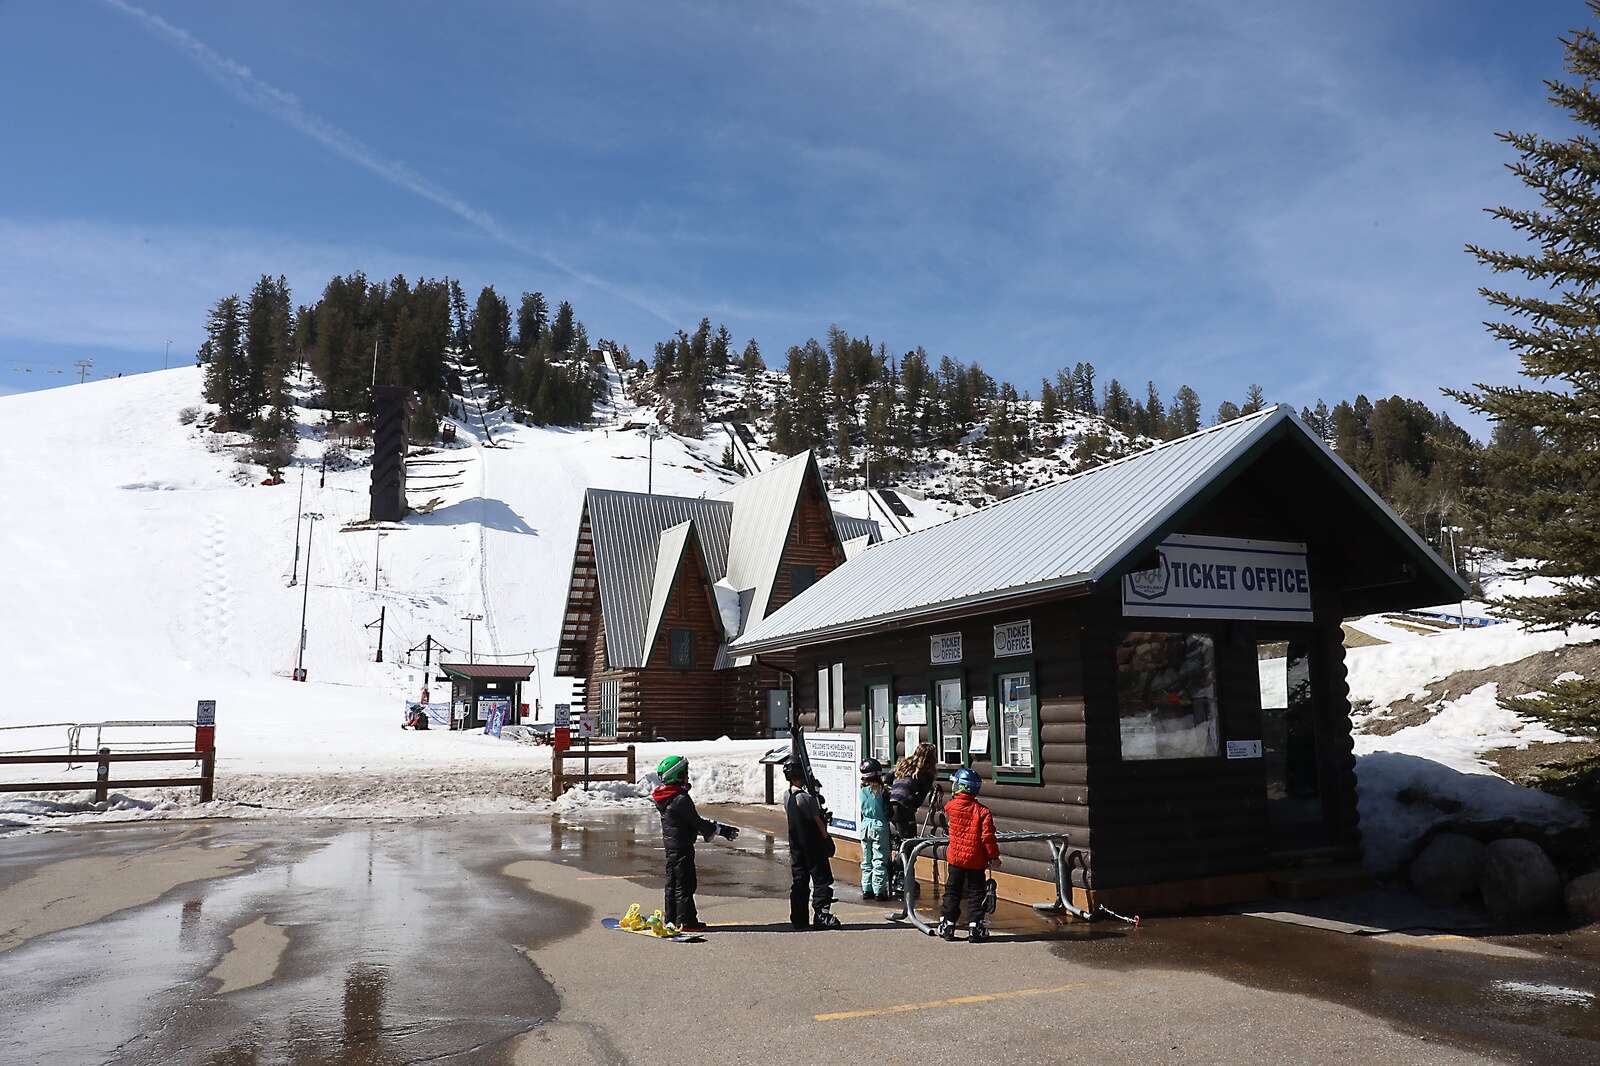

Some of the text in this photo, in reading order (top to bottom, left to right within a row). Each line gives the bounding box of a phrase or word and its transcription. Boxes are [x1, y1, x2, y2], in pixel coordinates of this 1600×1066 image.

[1170, 562, 1237, 590] TICKET
[1241, 566, 1309, 593] OFFICE
[1007, 625, 1030, 638] TICKET
[942, 637, 960, 648] TICKET
[1007, 637, 1031, 651] OFFICE
[942, 648, 960, 660] OFFICE
